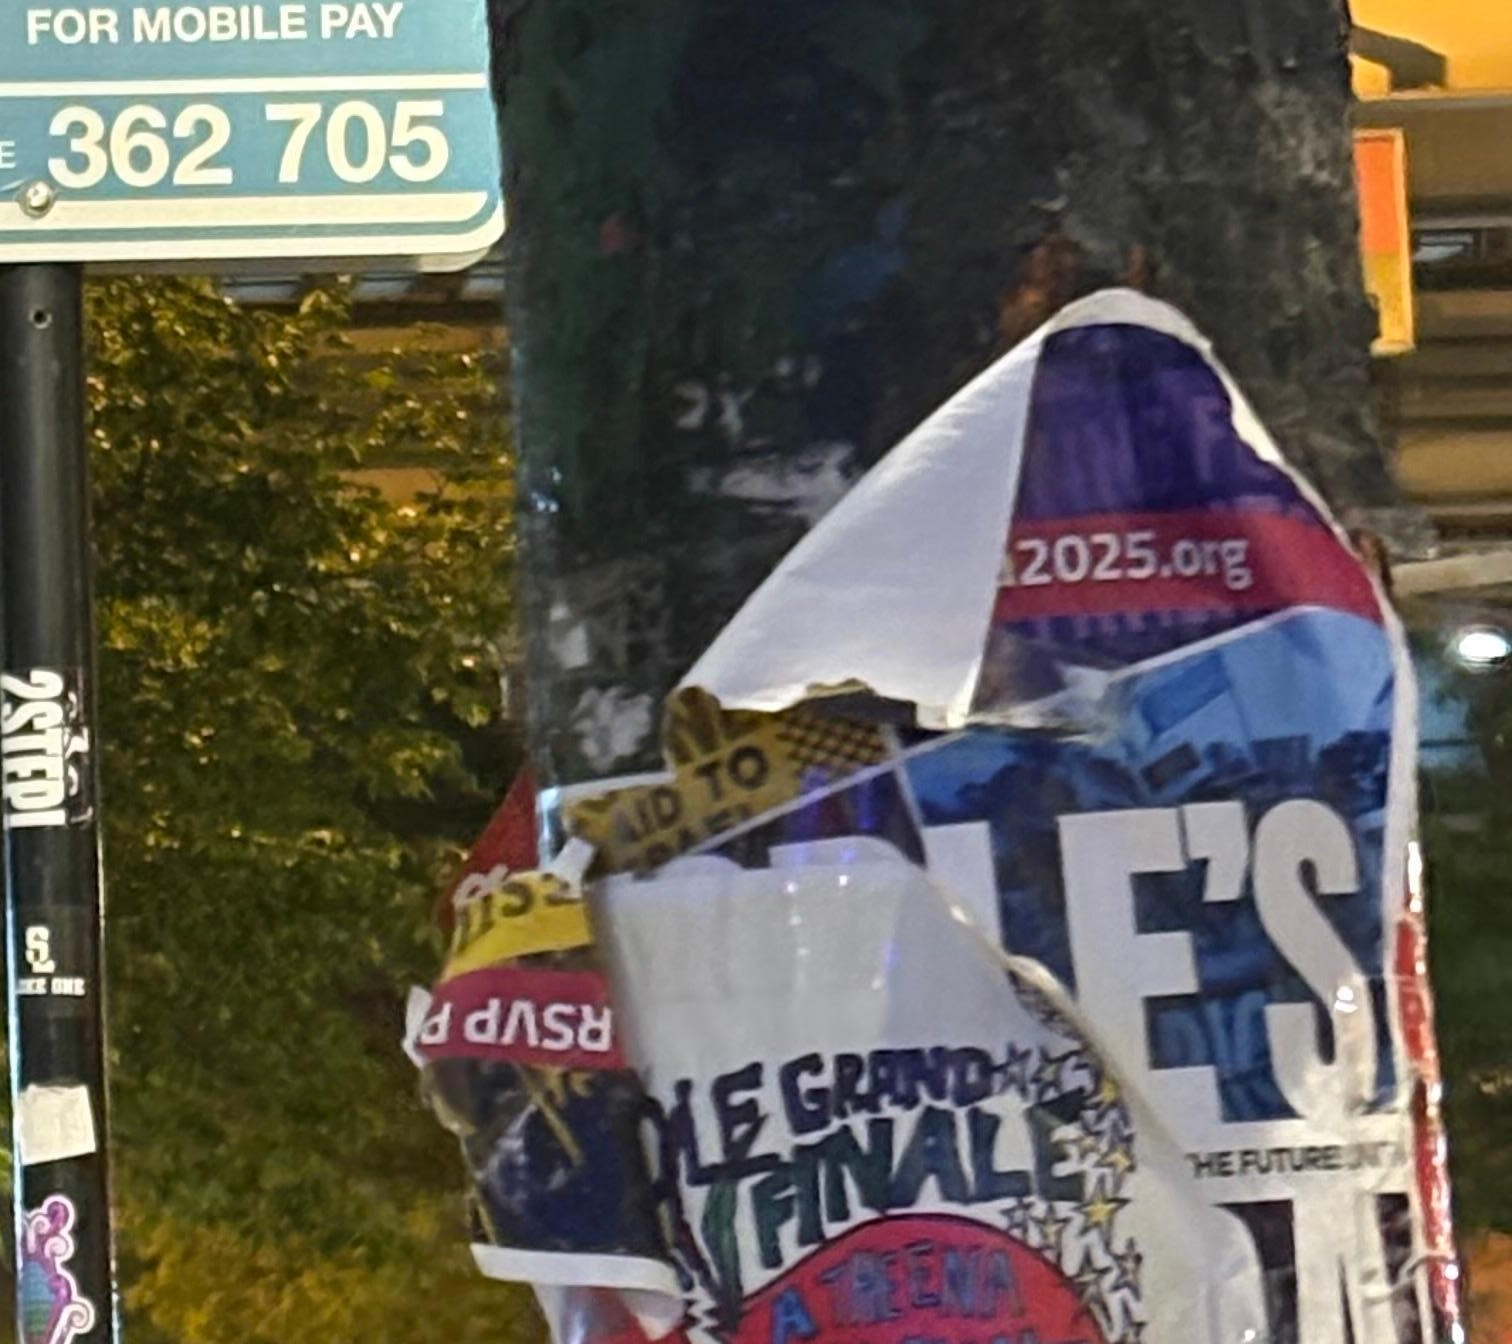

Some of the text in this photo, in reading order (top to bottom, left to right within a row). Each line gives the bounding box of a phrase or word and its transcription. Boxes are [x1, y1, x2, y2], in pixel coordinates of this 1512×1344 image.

[26, 1, 404, 45] FOR MOBILE PAY
[46, 103, 234, 190] 362
[264, 98, 450, 183] 705
[695, 744, 771, 803] TO
[464, 998, 613, 1053] RSVP
[779, 1046, 993, 1134] GRAND
[748, 1088, 1090, 1268] FINALE
[1239, 1143, 1346, 1174] FUTURE
